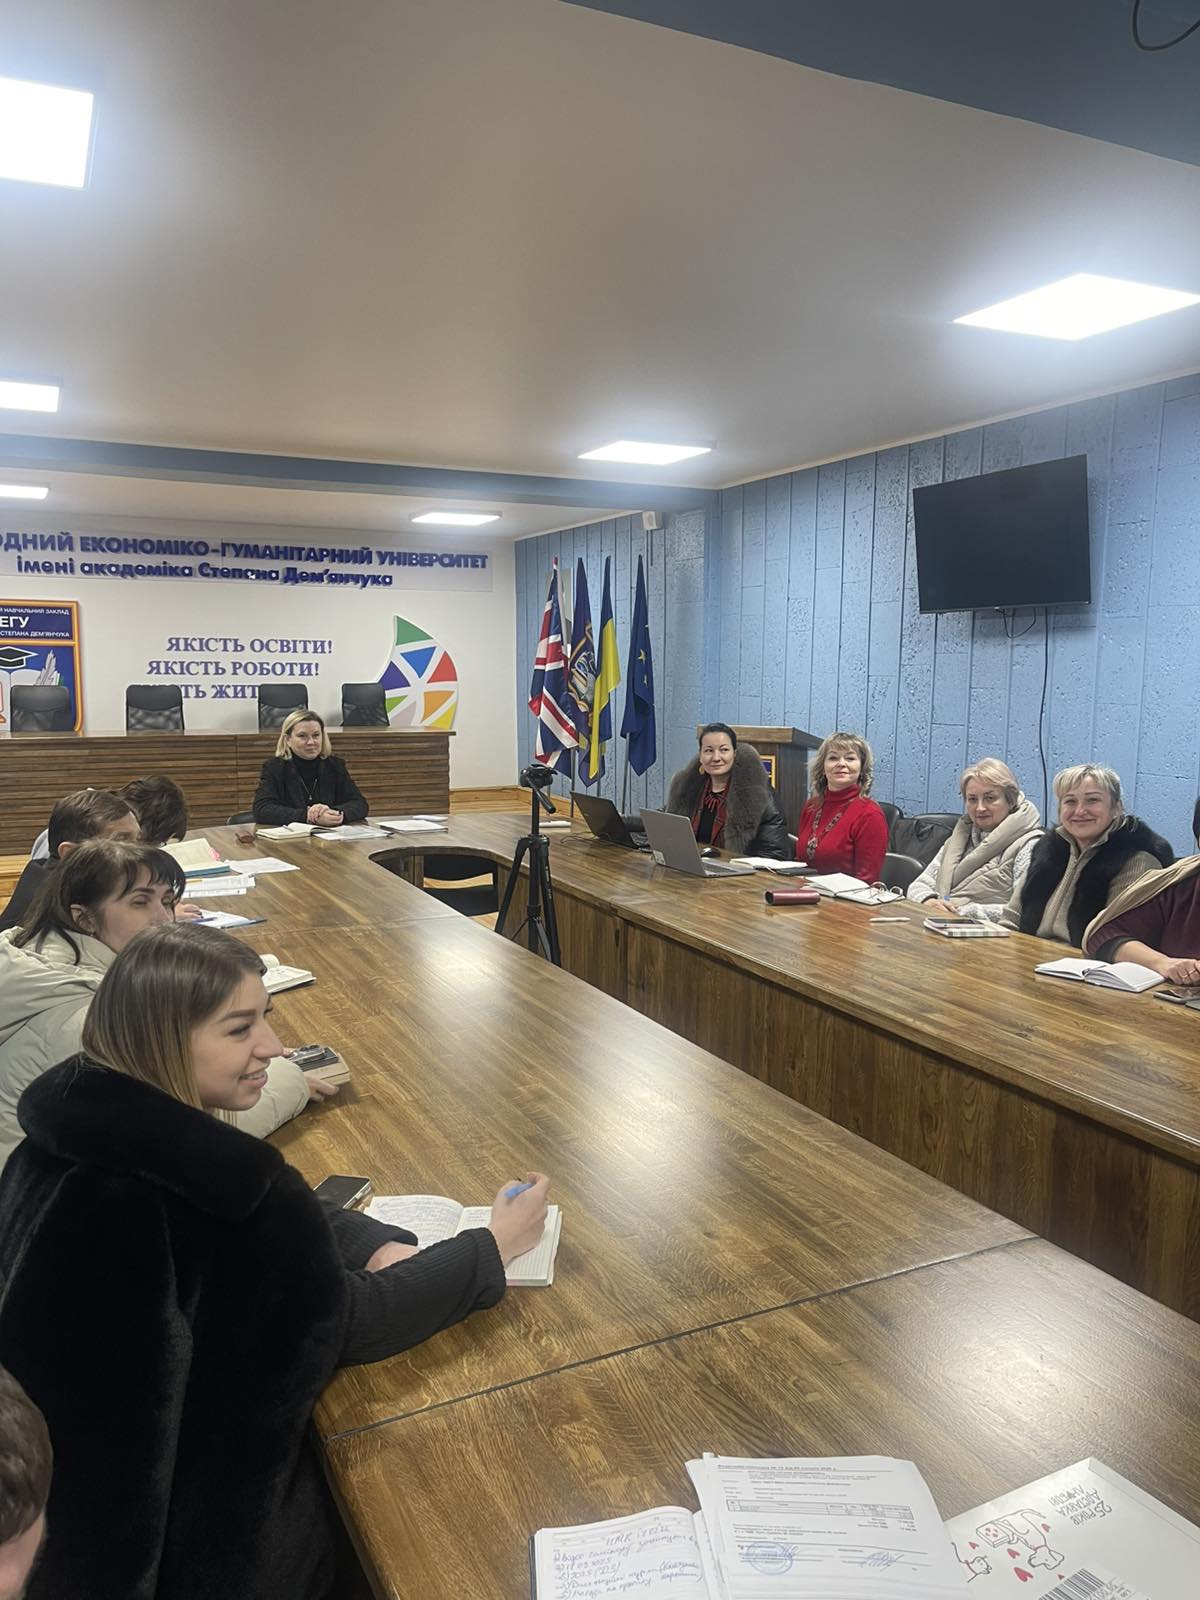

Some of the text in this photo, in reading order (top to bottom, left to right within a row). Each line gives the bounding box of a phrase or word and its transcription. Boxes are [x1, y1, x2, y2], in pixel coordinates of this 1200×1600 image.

[0, 531, 488, 569] ДНИЙ ЕКОНОМІКО-ГУМАНІТАРНИЙ УНІВЕРСИТЕТ
[17, 555, 75, 575] імені
[80, 561, 193, 579] академіка
[198, 563, 279, 582] Степана
[166, 637, 333, 654] ЯКІСТЬ ОСВІТИ!
[147, 660, 319, 676] ЯКІСТЬ РОБОТИ!
[181, 684, 260, 699] ТЬ ЖИТ
[1070, 1500, 1112, 1525] 25 РОКІВ
